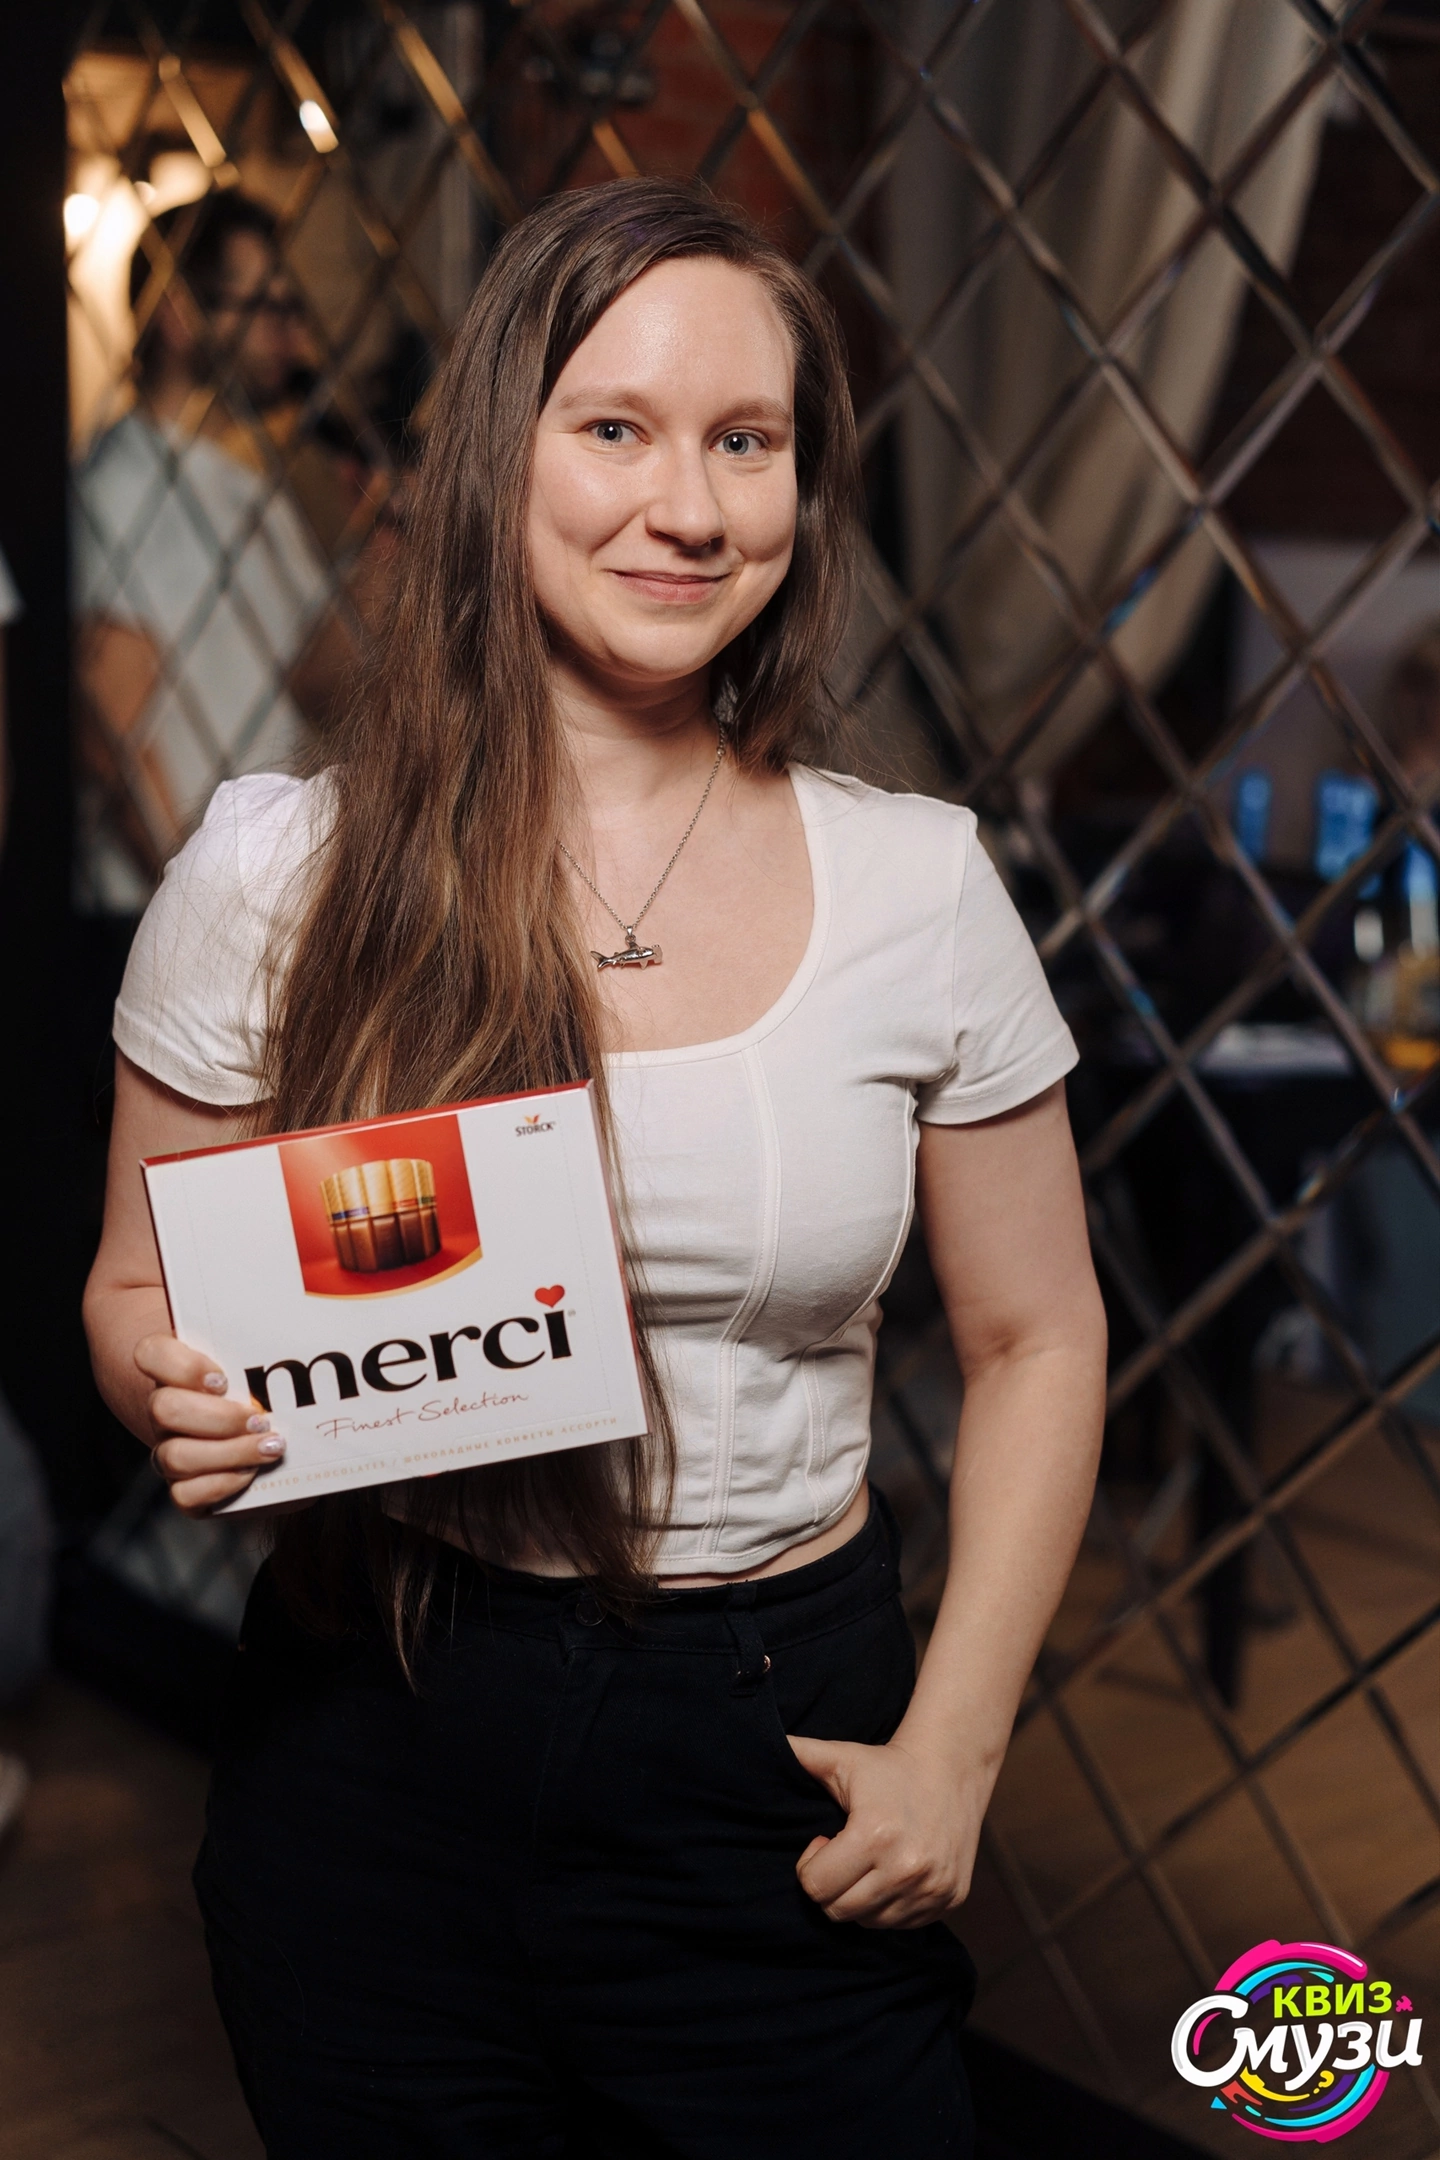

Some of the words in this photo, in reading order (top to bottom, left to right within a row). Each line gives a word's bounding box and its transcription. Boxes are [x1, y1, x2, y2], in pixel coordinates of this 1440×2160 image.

[515, 1122, 554, 1137] STORCK
[244, 1284, 574, 1413] merci
[316, 1408, 415, 1439] Finest
[418, 1391, 529, 1421] Selection
[251, 1477, 299, 1492] SORTED
[306, 1460, 386, 1482] CHOCOLATES
[404, 1441, 489, 1464] ШОКОЛАДНЫЕ
[496, 1430, 554, 1447] КОНФЕТЫ
[560, 1417, 617, 1433] АССОРТИ
